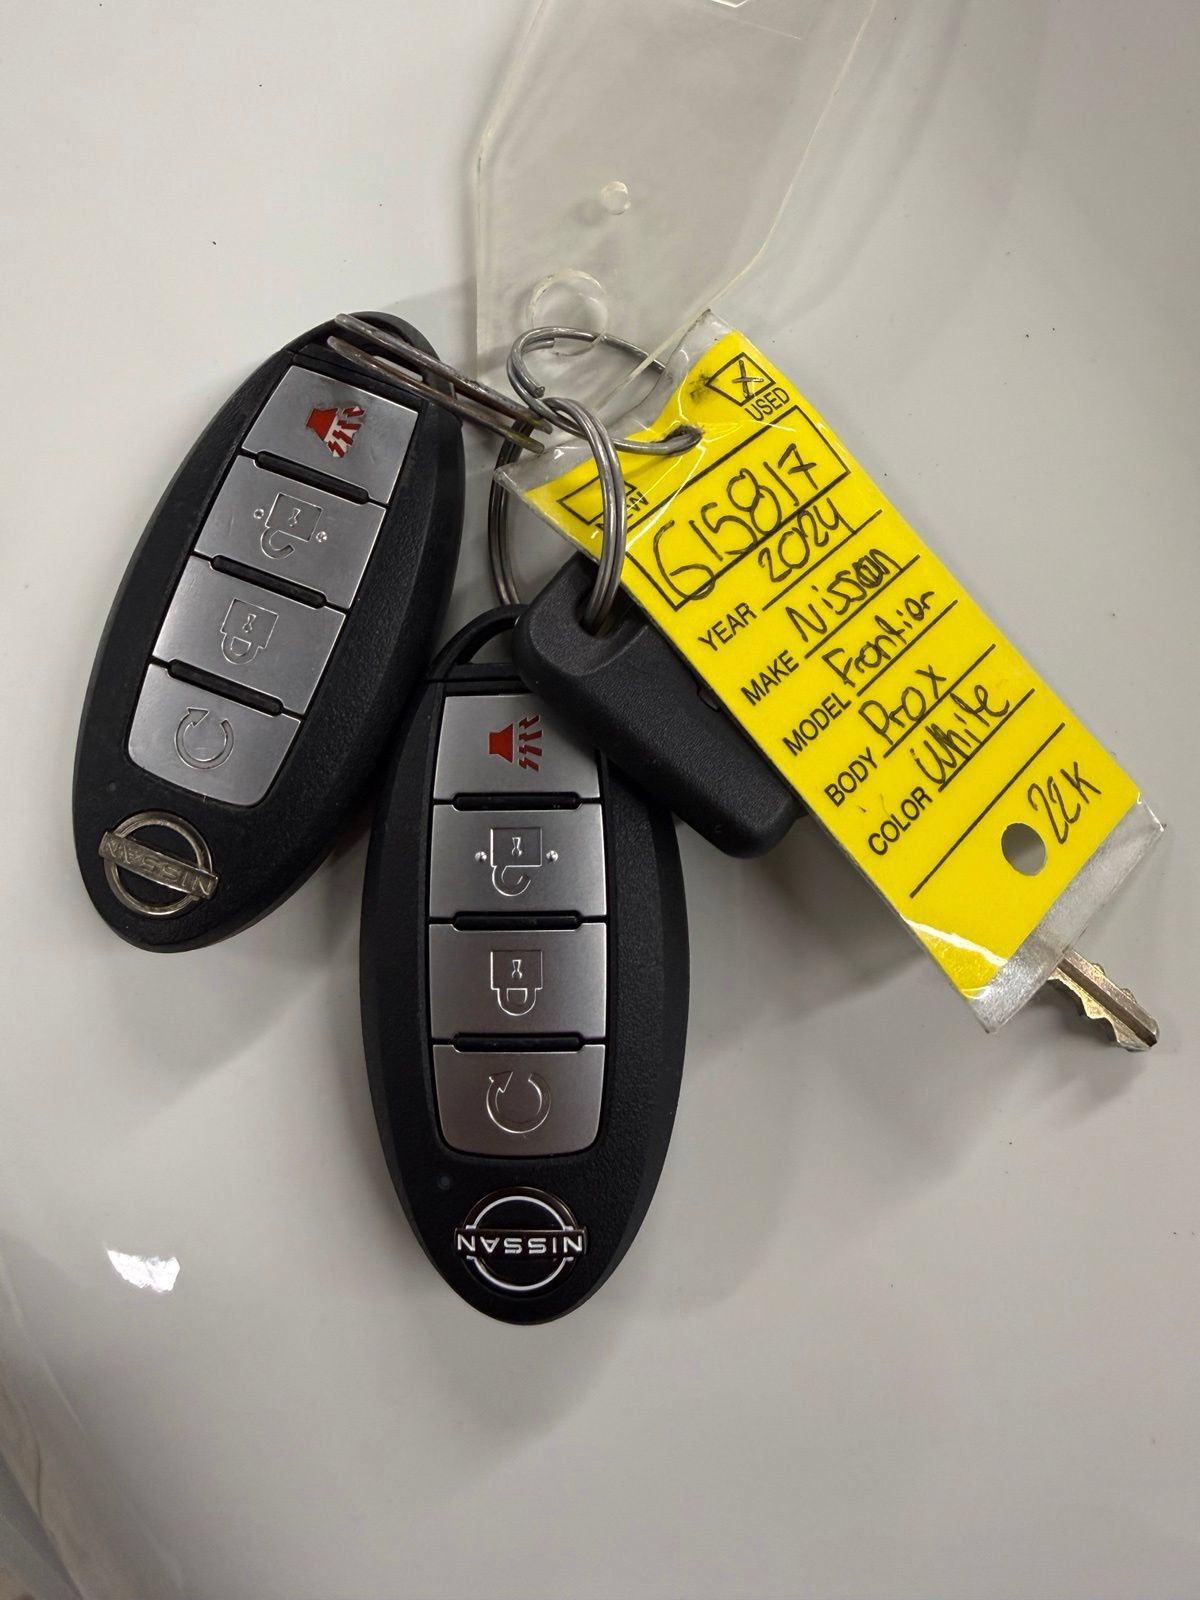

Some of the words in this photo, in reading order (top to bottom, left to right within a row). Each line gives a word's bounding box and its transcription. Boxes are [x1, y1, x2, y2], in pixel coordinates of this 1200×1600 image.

[745, 386, 791, 422] USED
[697, 602, 757, 652] YEAR
[757, 497, 857, 583] 2024
[740, 650, 800, 706] MAKE
[784, 548, 904, 643] Nissan
[782, 692, 852, 757] MODEL
[821, 591, 935, 688] Frontier
[823, 747, 879, 807] BODY
[867, 786, 933, 856] COLOR
[910, 685, 1010, 784] White
[1027, 761, 1102, 845] 22K
[104, 836, 215, 897] NISSAN
[457, 1233, 583, 1255] NISSAN
